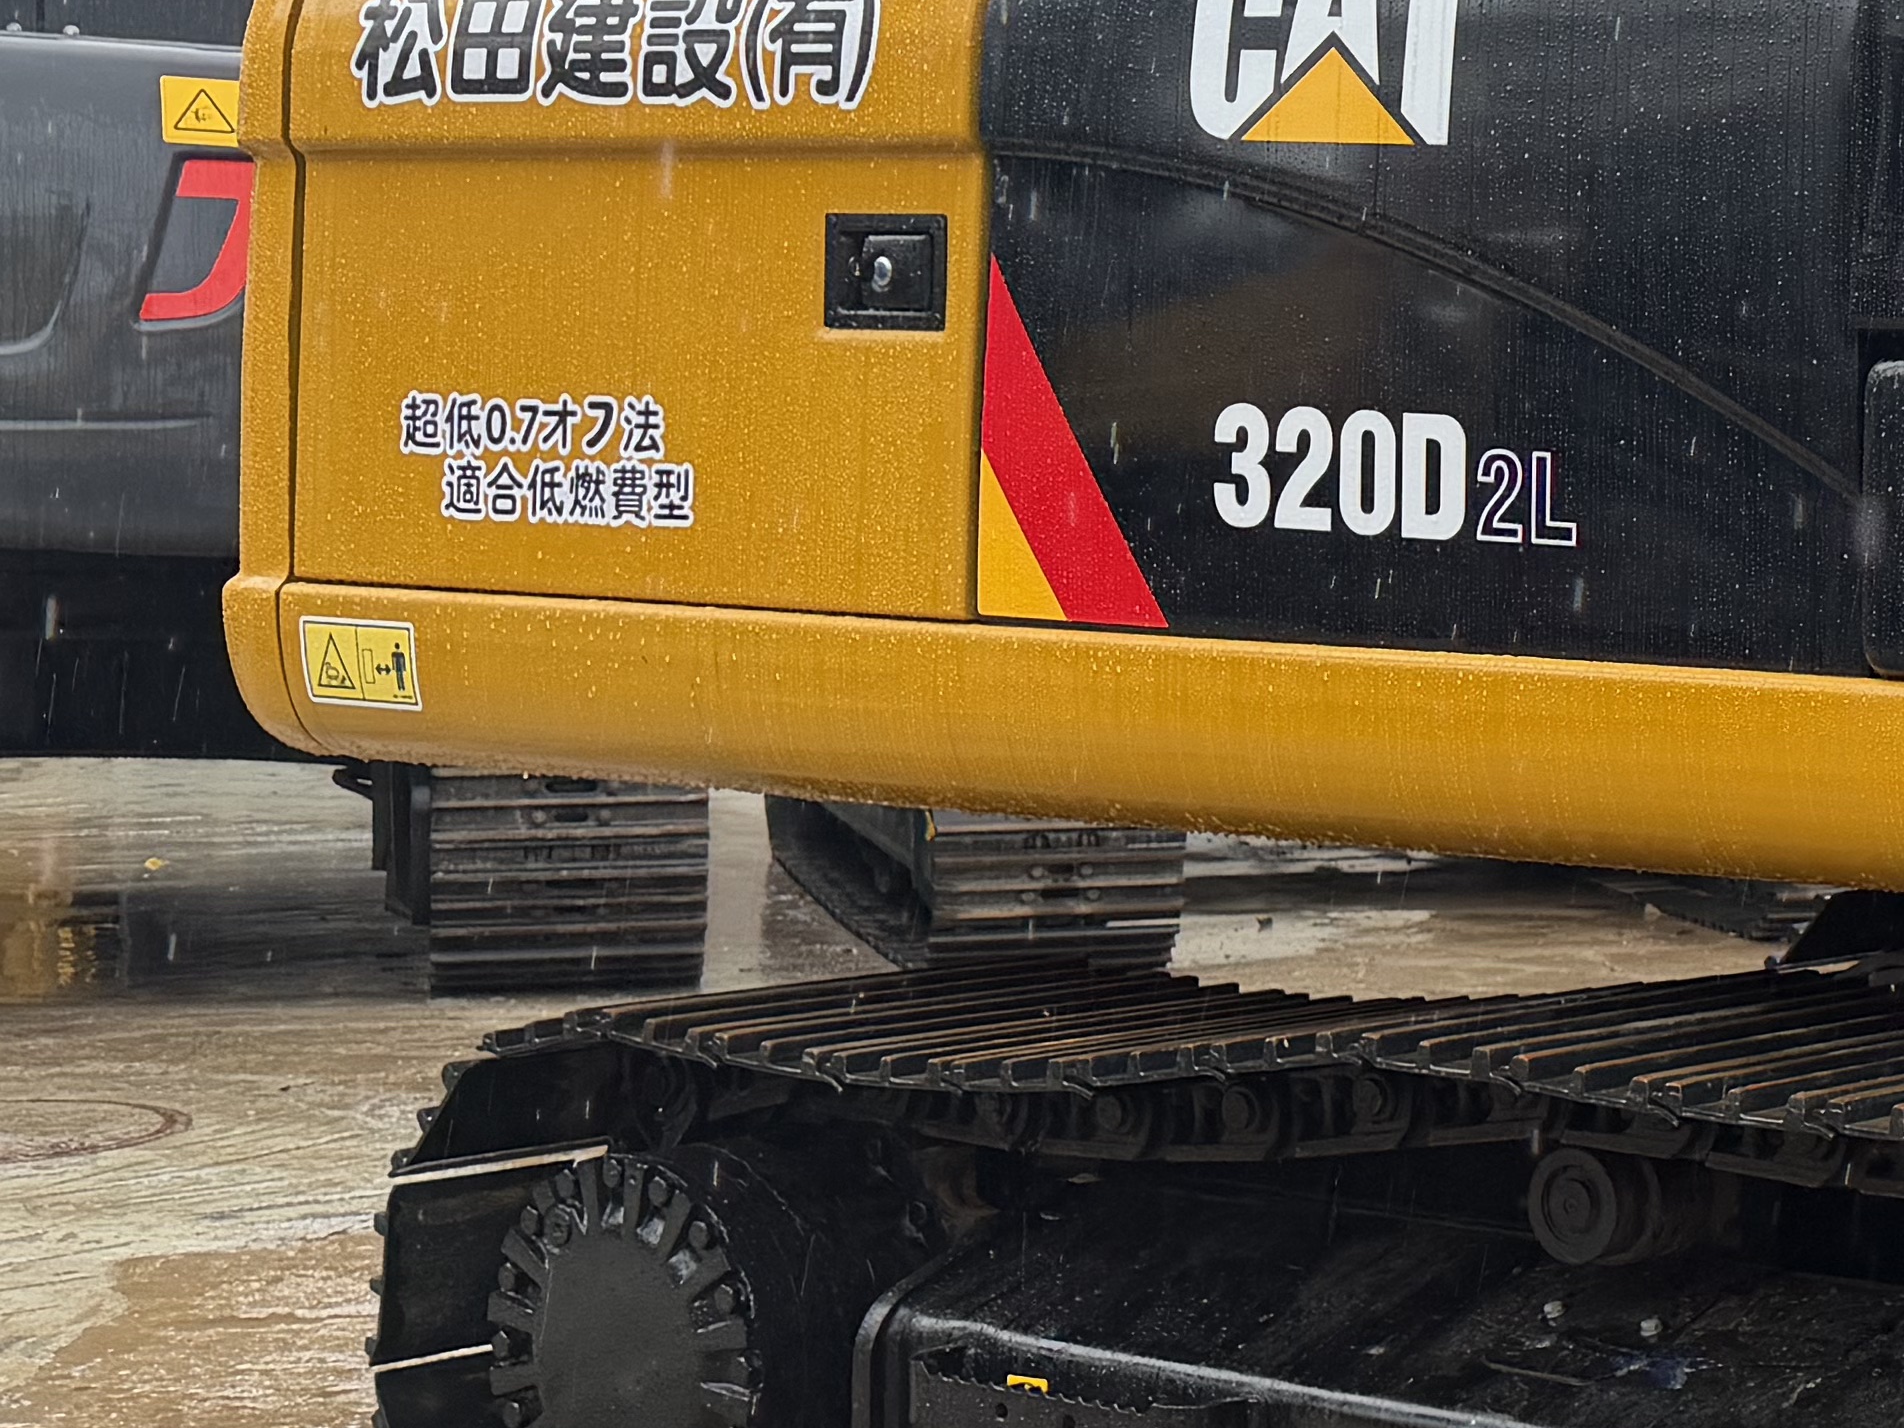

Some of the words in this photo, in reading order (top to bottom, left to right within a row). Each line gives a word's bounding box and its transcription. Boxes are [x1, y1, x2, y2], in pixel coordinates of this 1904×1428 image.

[400, 392, 668, 456] 超低0.7オフ法
[440, 460, 696, 526] 適合低燃費型
